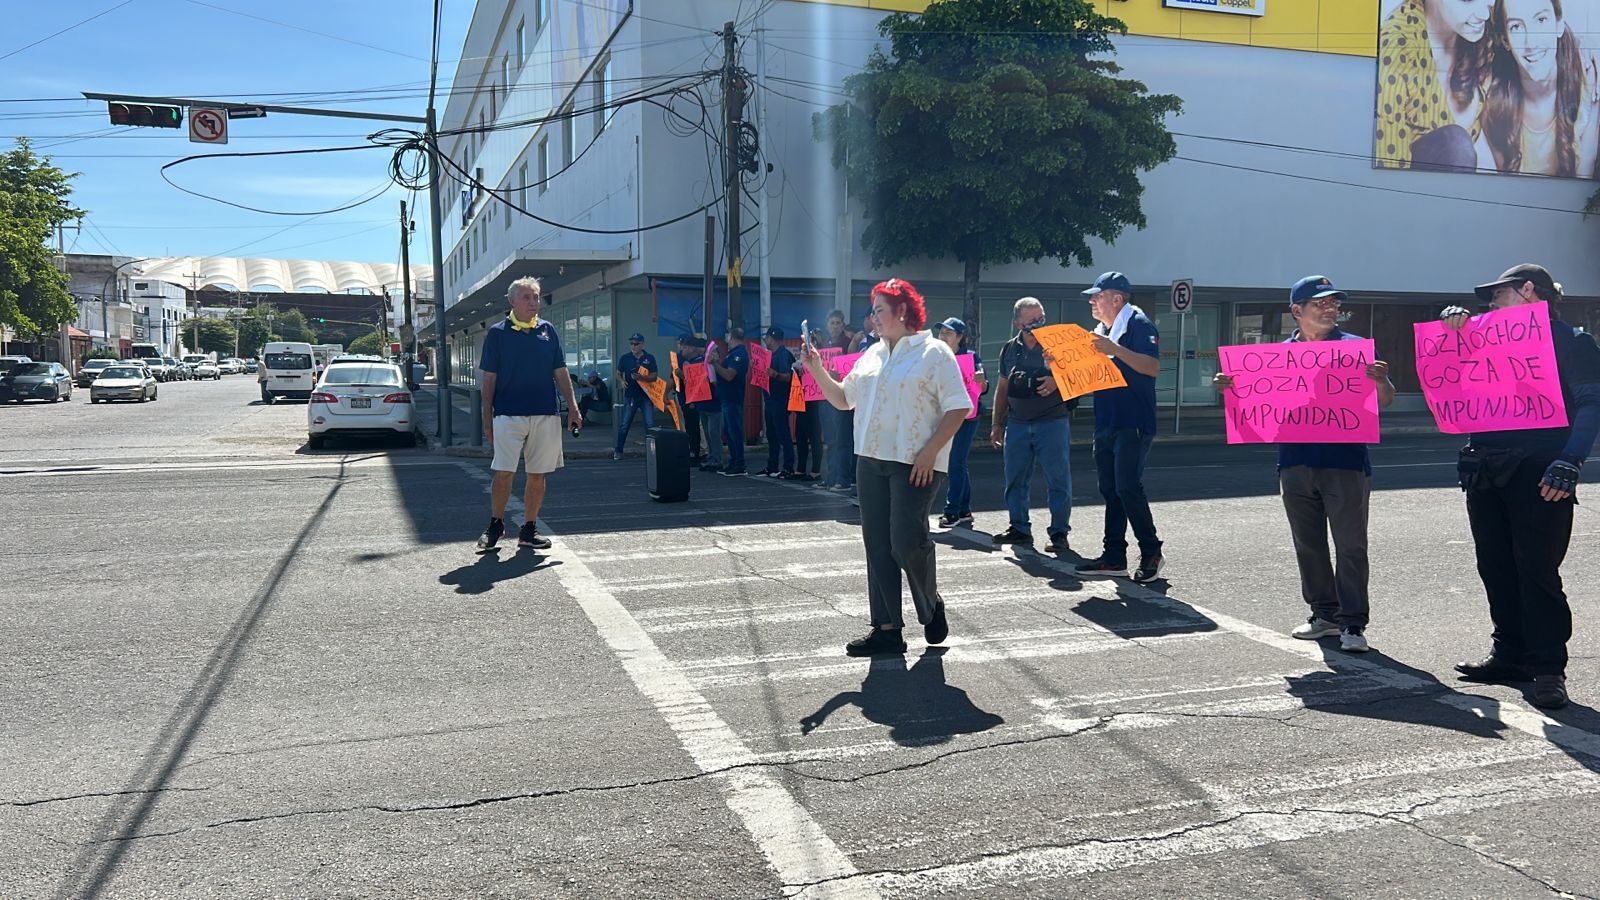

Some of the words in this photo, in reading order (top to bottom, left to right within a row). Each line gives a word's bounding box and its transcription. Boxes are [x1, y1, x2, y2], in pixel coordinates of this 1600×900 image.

[1417, 311, 1542, 359] LOZAOCHOA
[1224, 348, 1368, 373] LOZAOCHOA
[1422, 357, 1500, 389] GOZA
[1507, 356, 1545, 381] DE
[1231, 374, 1308, 398] GOZA
[1326, 374, 1363, 394] DE
[1232, 403, 1361, 431] IMPUNIDAD
